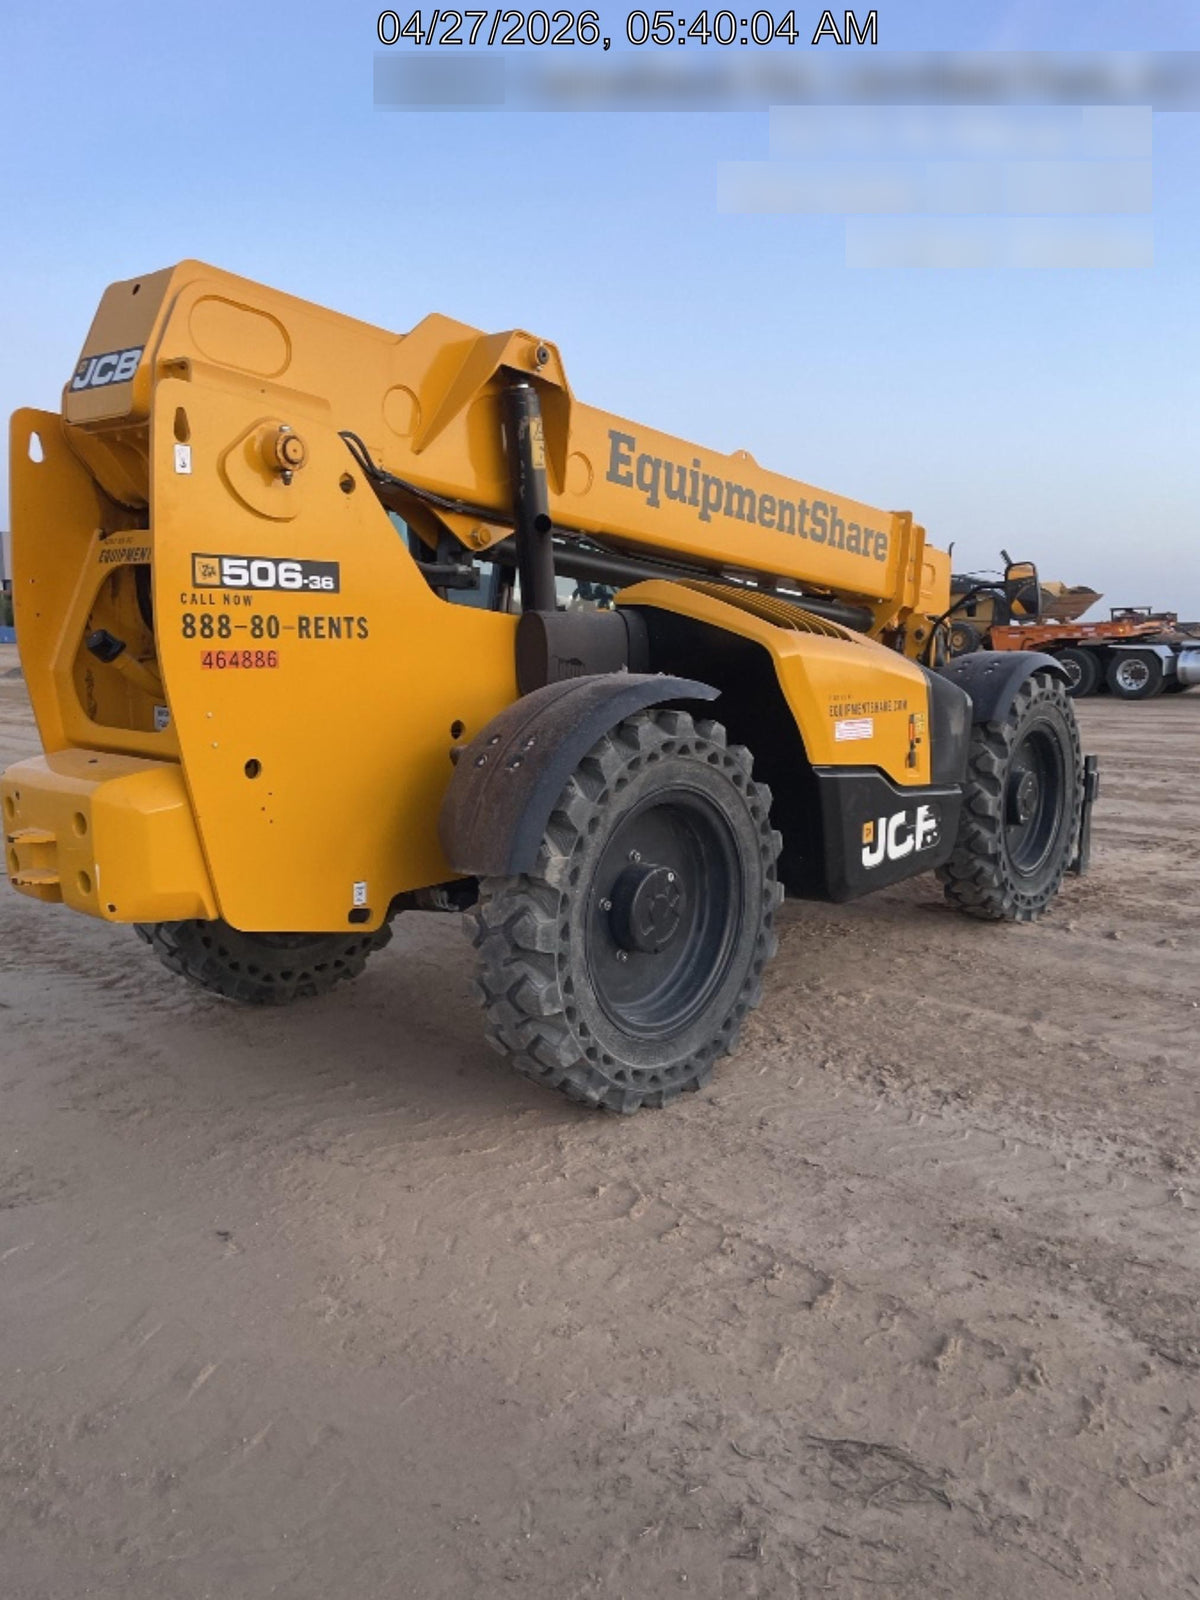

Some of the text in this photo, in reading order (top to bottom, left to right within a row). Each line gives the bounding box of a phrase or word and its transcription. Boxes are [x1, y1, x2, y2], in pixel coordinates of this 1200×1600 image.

[71, 348, 143, 389] JCB
[605, 429, 889, 562] EquipmentShare
[180, 593, 254, 607] CALL NOW
[181, 612, 370, 640] 888-80-RENTS
[201, 650, 279, 669] 464886
